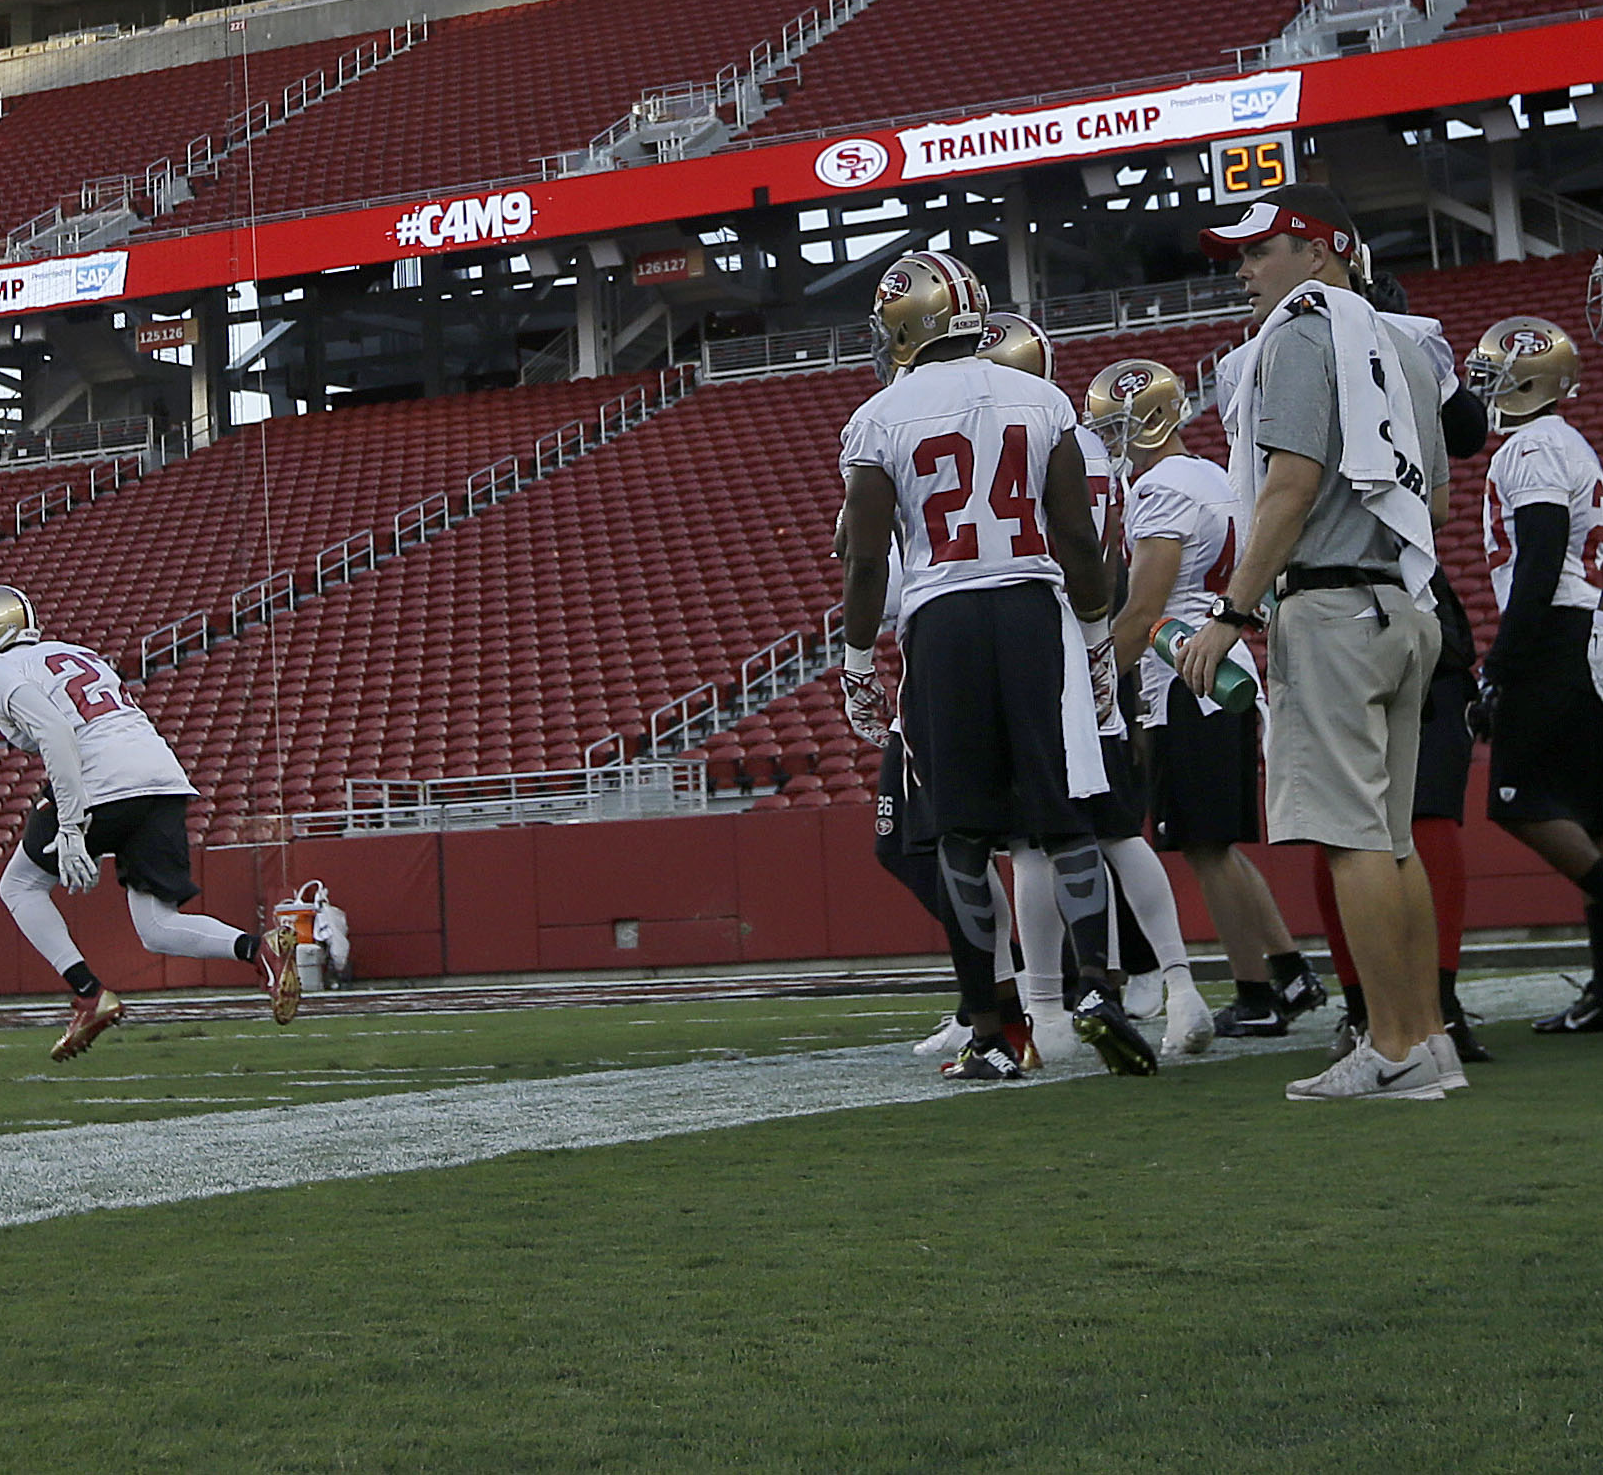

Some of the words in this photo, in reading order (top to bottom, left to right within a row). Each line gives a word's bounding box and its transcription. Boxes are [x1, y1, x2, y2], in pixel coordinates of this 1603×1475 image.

[920, 121, 1063, 164] TRAINING
[1077, 106, 1160, 140] CAMP
[1170, 93, 1216, 108] Presented
[1217, 92, 1226, 104] by
[1231, 89, 1278, 118] SAP
[1225, 142, 1284, 191] 25
[395, 191, 532, 248] #C4M9
[77, 266, 110, 290] SAP
[637, 260, 662, 276] 126
[663, 257, 686, 272] 127
[140, 329, 161, 344] 125
[162, 327, 184, 341] 126
[912, 424, 1047, 567] 24
[877, 795, 894, 817] 26
